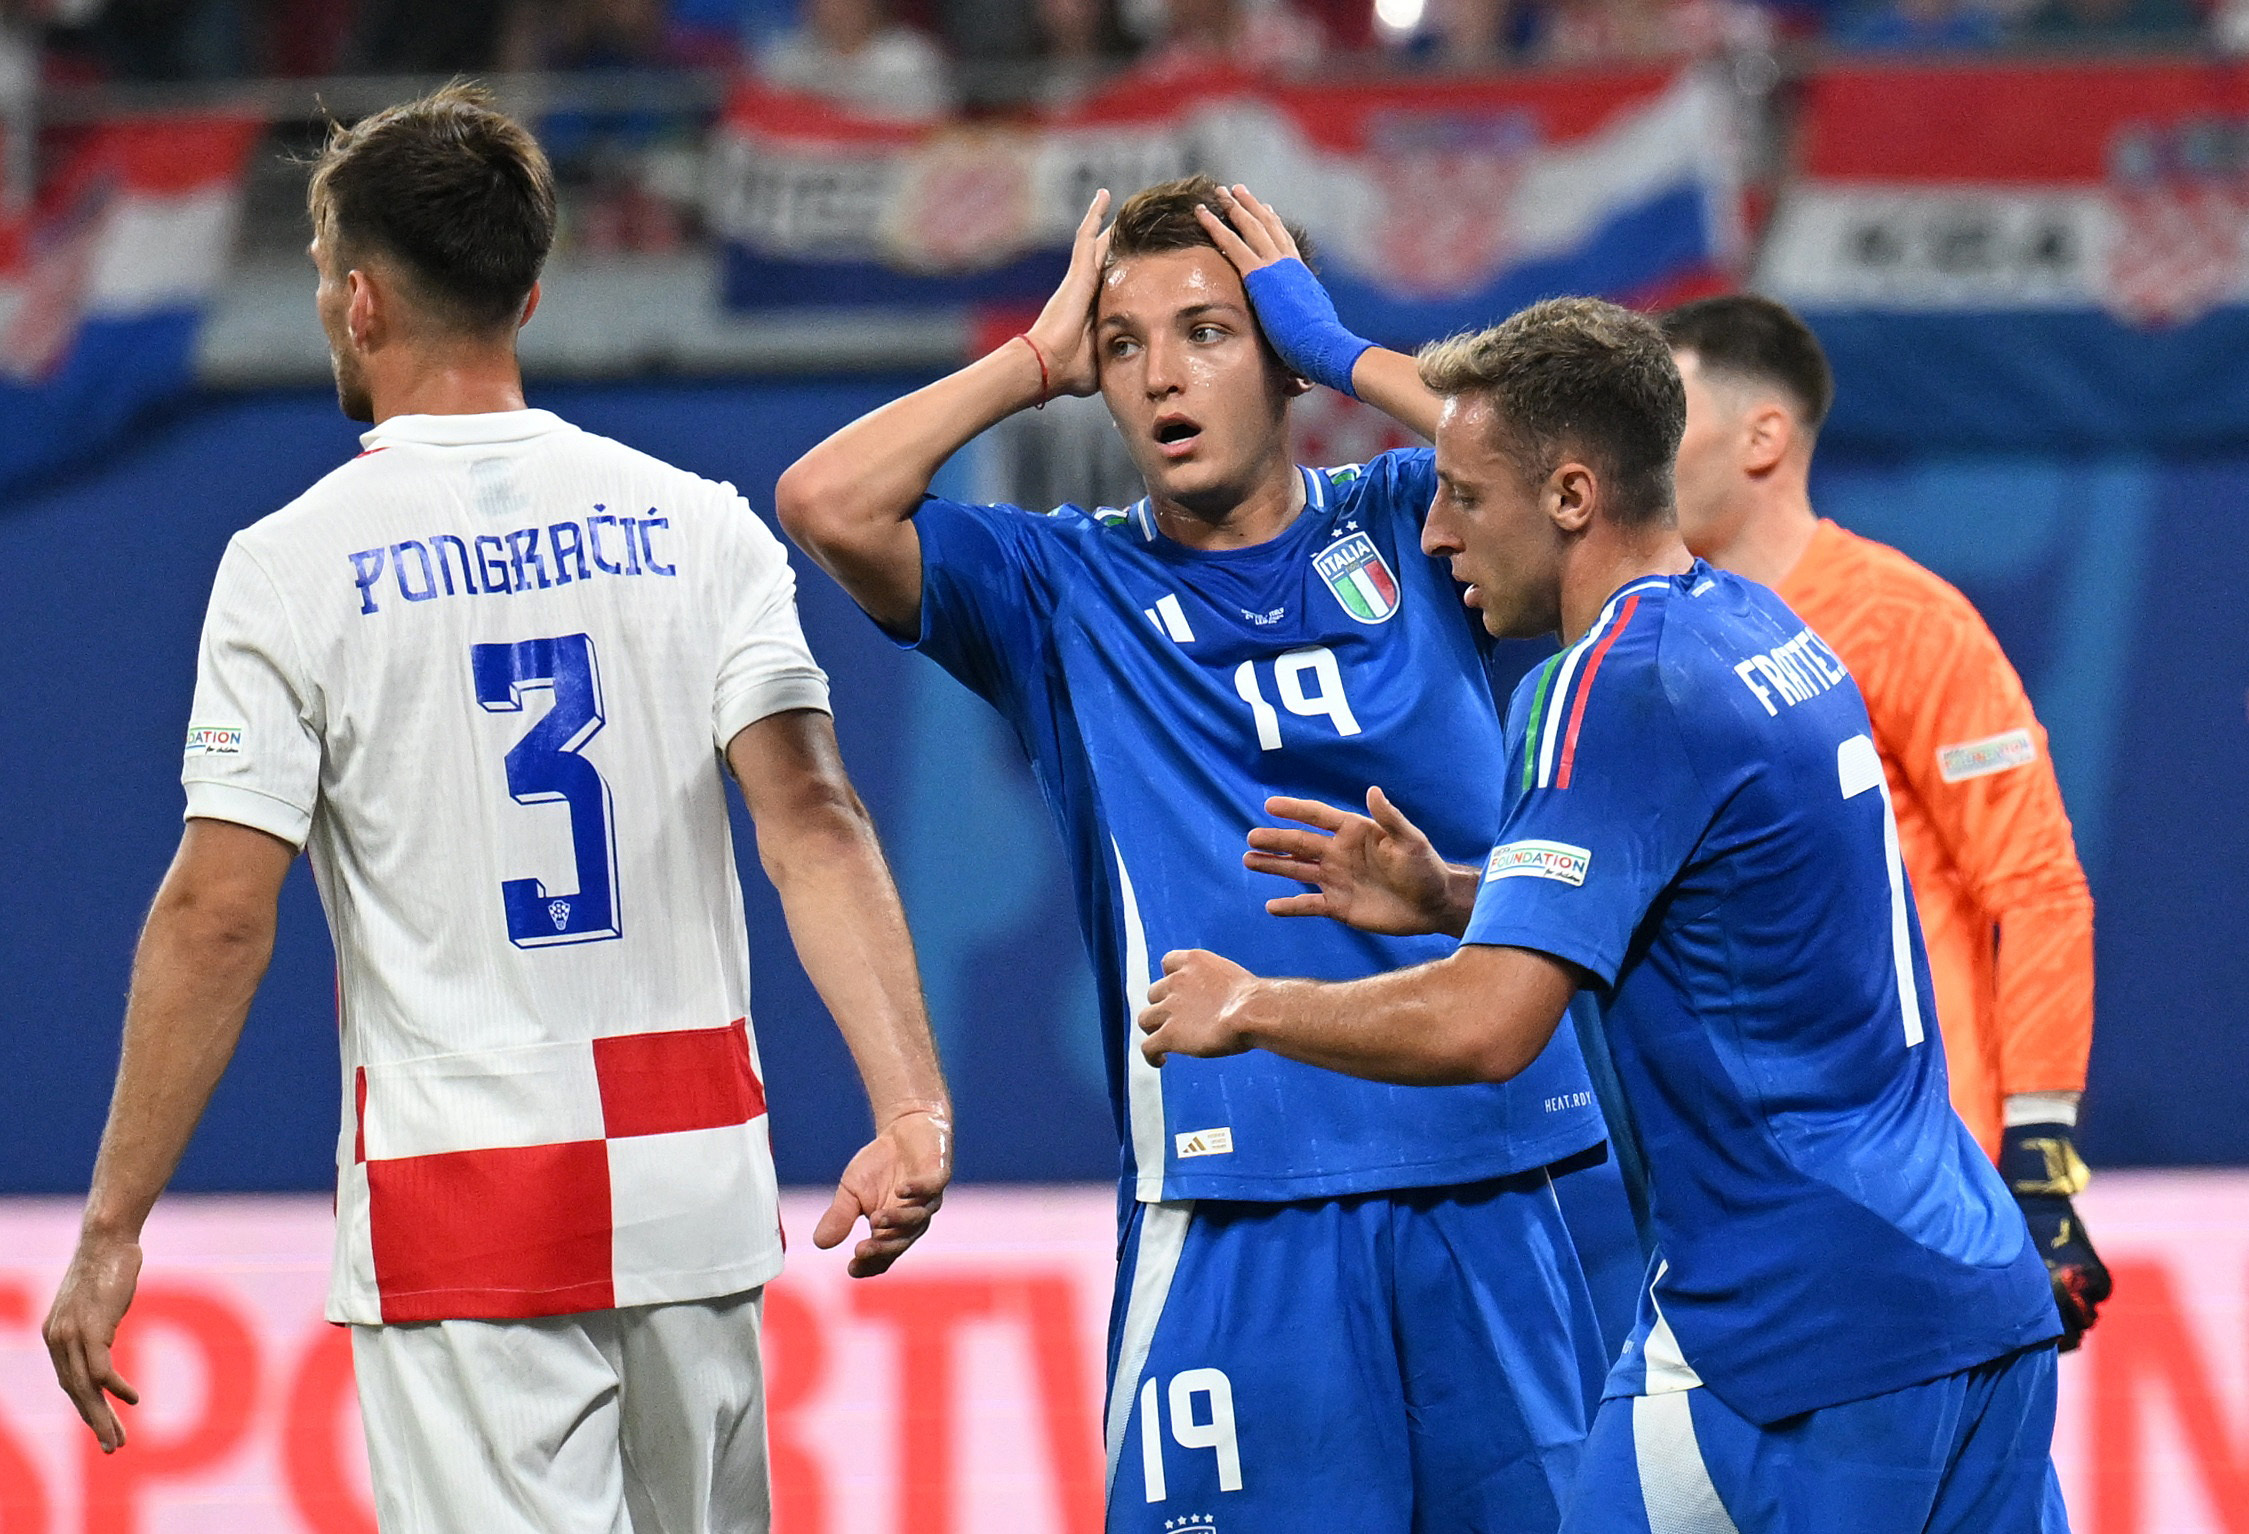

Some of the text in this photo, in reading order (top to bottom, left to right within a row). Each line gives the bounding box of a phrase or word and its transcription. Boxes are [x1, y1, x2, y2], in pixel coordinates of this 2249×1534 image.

[348, 503, 677, 615] PONGRAČIĆ
[1319, 540, 1371, 577] ITALIA
[1234, 645, 1362, 751] 19
[469, 632, 623, 950] 3
[1490, 852, 1586, 874] FOUNDATION
[1544, 1091, 1592, 1113] HEAT.RDY
[1140, 1367, 1243, 1504] 19
